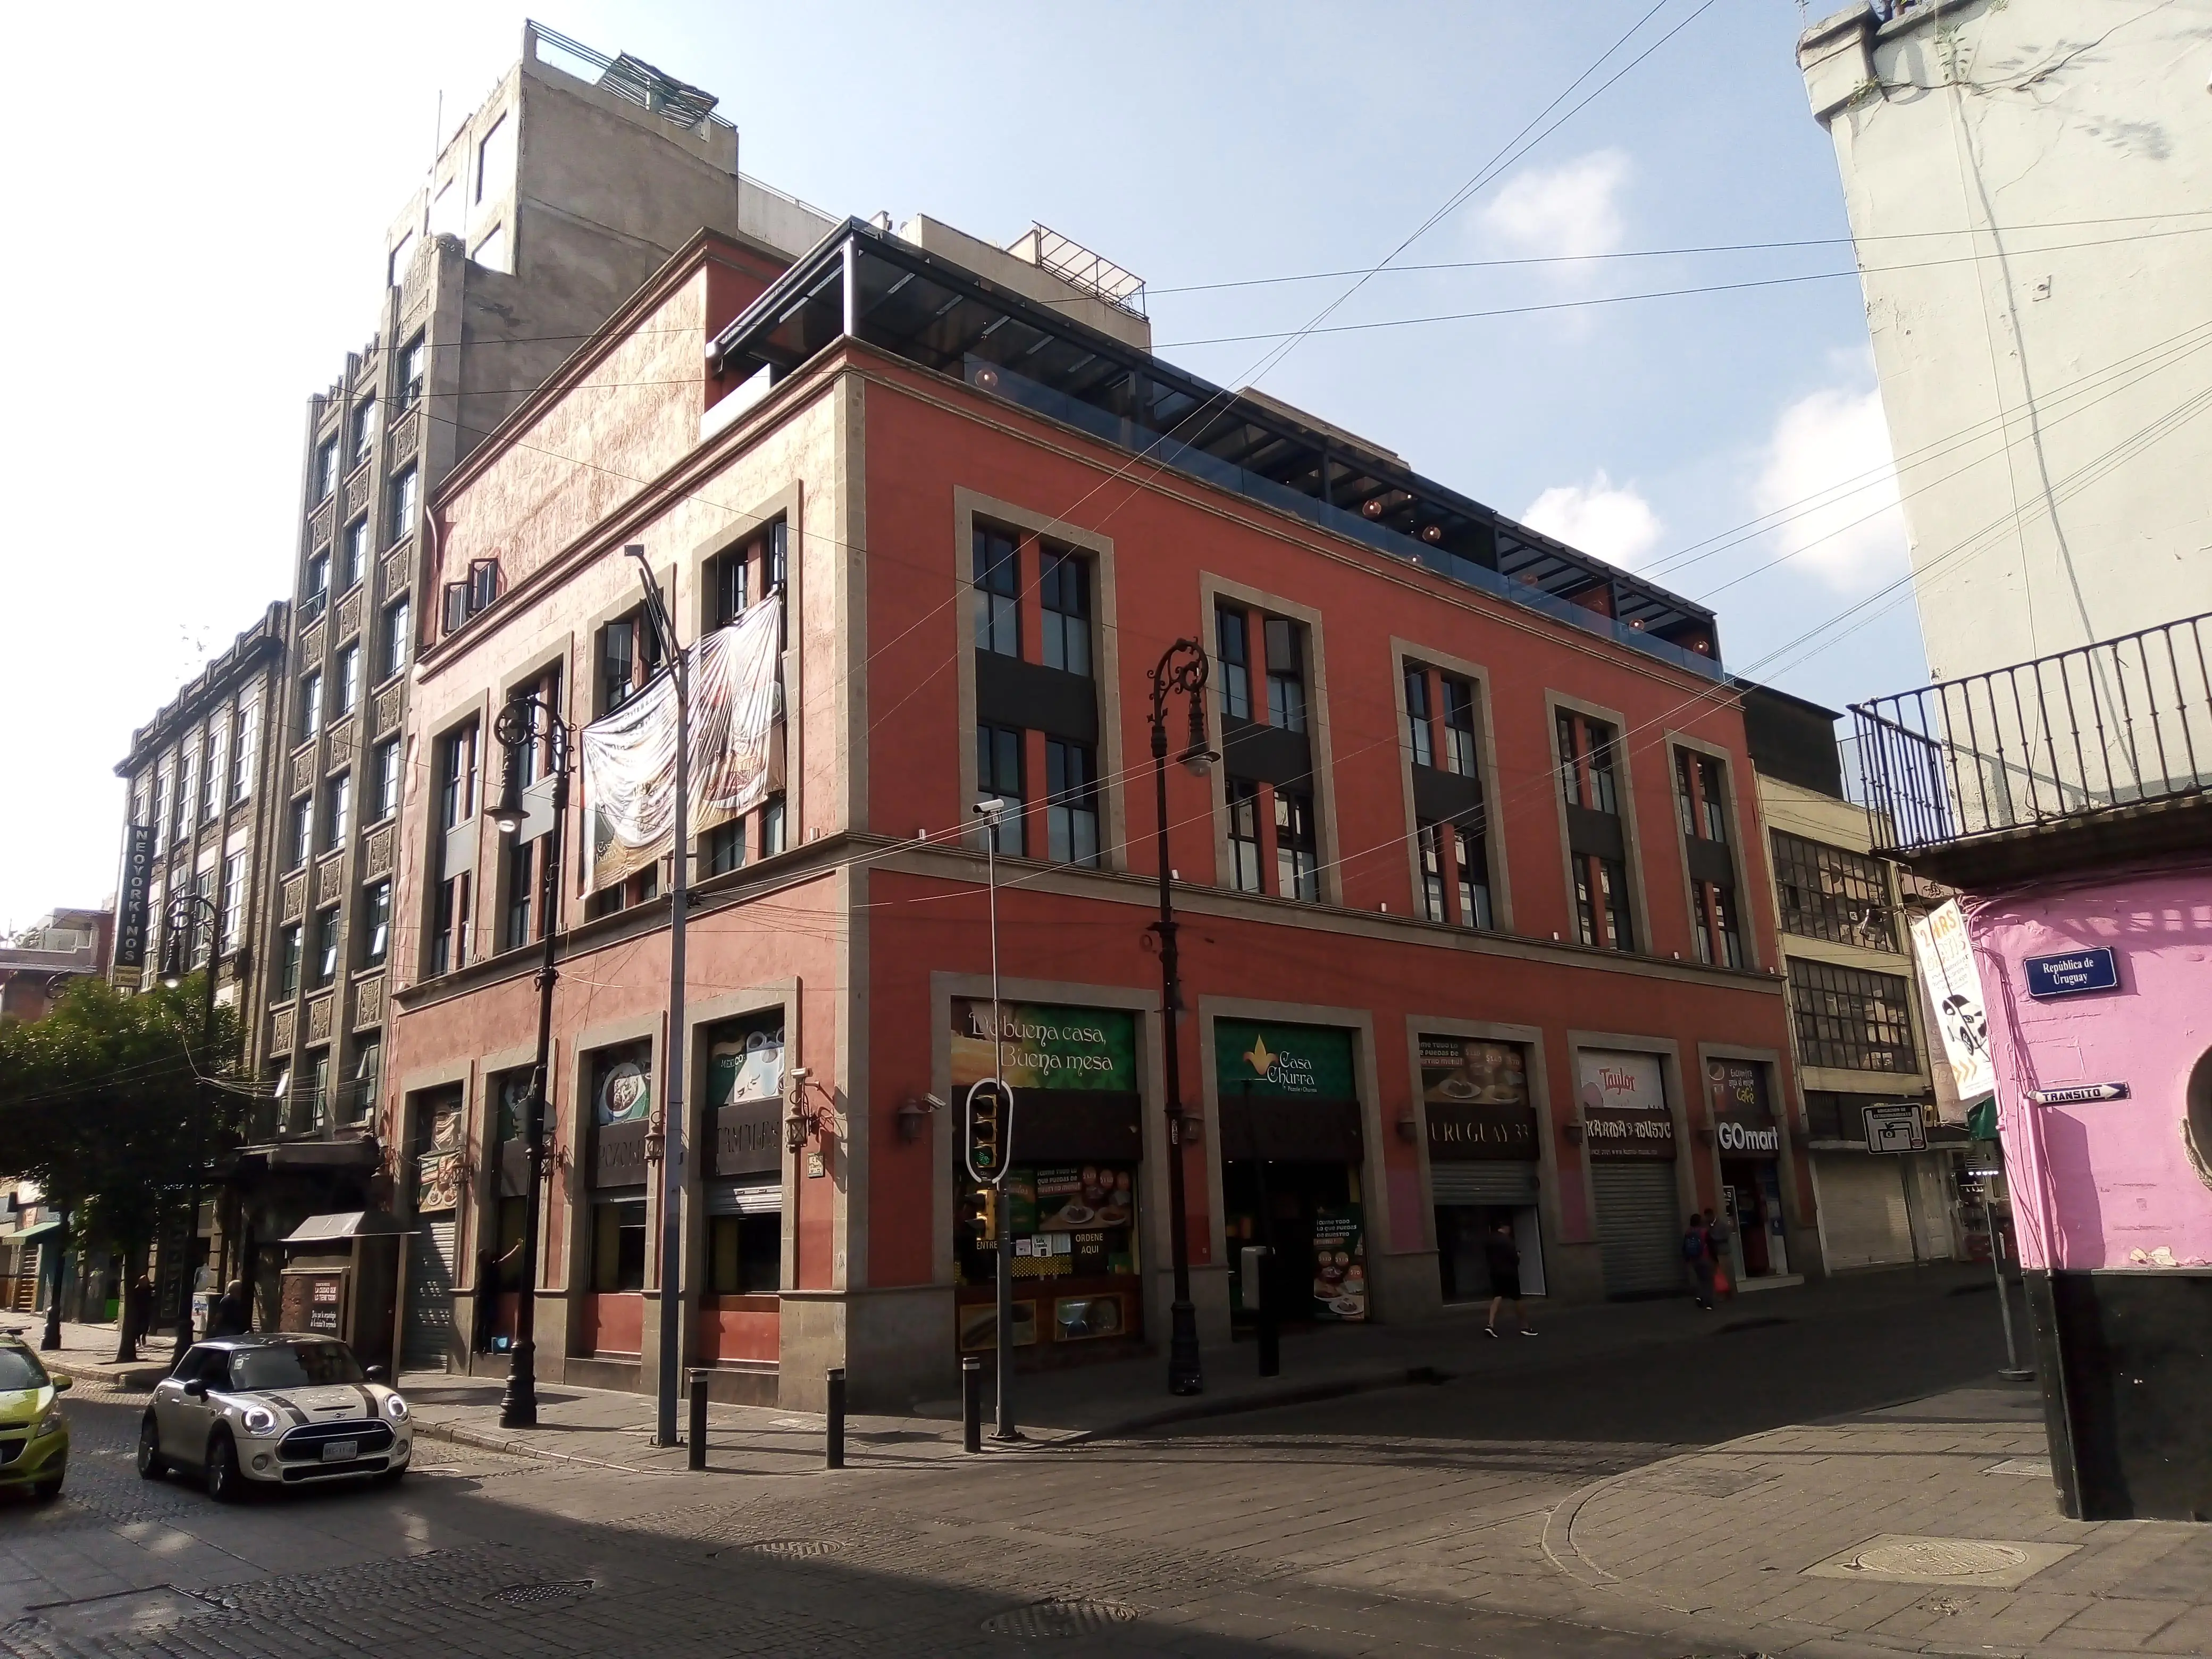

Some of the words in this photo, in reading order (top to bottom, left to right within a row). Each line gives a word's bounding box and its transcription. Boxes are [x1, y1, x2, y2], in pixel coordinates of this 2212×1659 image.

[125, 830, 148, 961] NEOYORKINOS
[2042, 959, 2083, 974] República
[2084, 957, 2094, 968] de
[2053, 973, 2088, 986] Uruguay
[1003, 1015, 1059, 1047] buena
[1000, 1042, 1062, 1076] Buena
[1066, 1055, 1113, 1077] mesa
[1279, 1051, 1312, 1070] Casa
[1267, 1066, 1315, 1089] Churra
[1598, 1067, 1636, 1095] Taylor
[2042, 1088, 2101, 1101] TRANSITO
[717, 1121, 780, 1154] TAMALES
[1430, 1121, 1508, 1143] URUGUAY
[1514, 1124, 1529, 1142] 33
[1719, 1121, 1779, 1150] GOmart
[976, 1240, 998, 1250] ENTRE
[1075, 1233, 1103, 1242] ORDENE
[1081, 1245, 1099, 1254] AQUI
